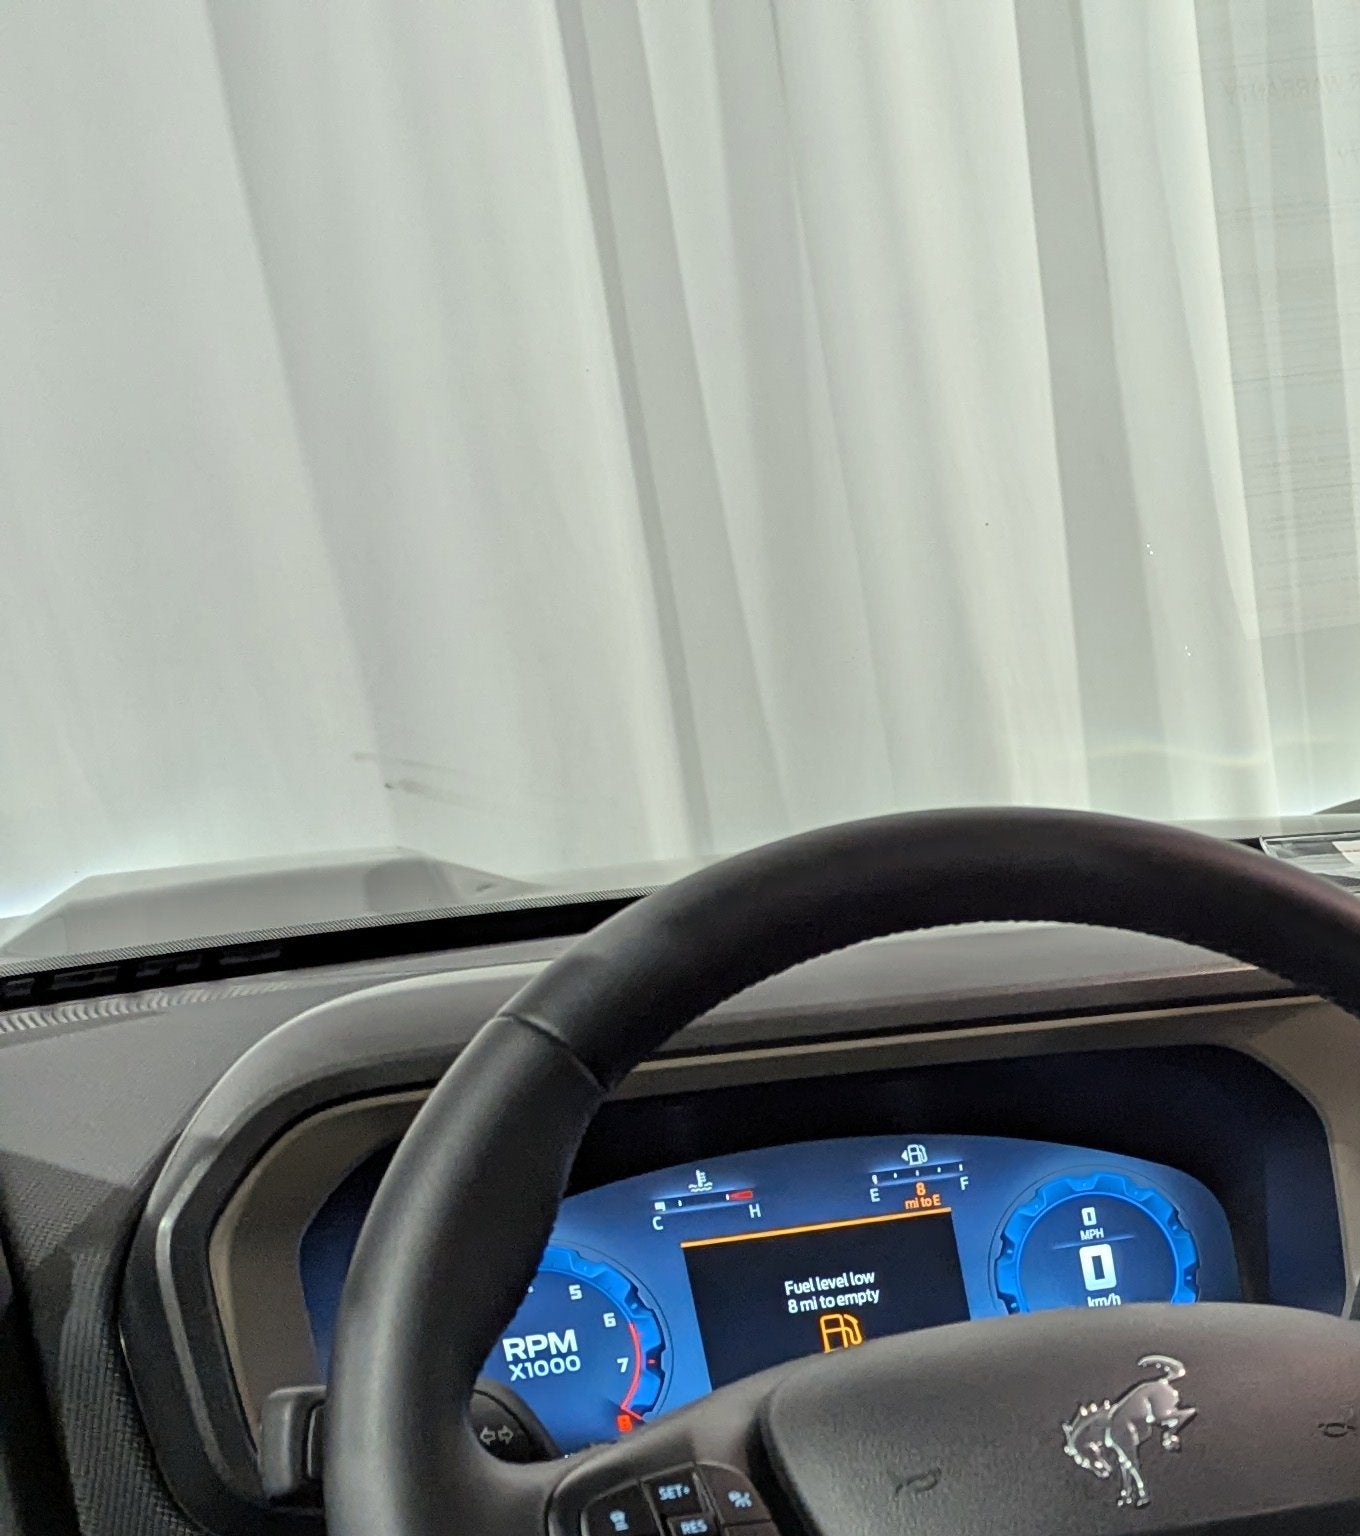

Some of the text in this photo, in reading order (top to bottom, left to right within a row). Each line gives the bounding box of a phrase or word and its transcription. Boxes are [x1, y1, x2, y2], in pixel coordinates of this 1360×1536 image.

[915, 1182, 926, 1196] 8
[960, 1176, 969, 1191] F
[869, 1188, 881, 1203] E
[904, 1193, 941, 1209] mi to E
[749, 1204, 762, 1218] H
[1081, 1207, 1097, 1226] 0
[652, 1216, 664, 1231] C
[1080, 1227, 1104, 1240] MPH
[1079, 1243, 1117, 1291] 0
[784, 1271, 875, 1296] Fuel level low
[568, 1284, 583, 1300] 5
[787, 1288, 880, 1314] 8 mi to empty
[1087, 1293, 1121, 1308] km/h
[603, 1312, 617, 1328] 6
[502, 1328, 578, 1362] RPM
[508, 1355, 581, 1382] X1000
[617, 1357, 629, 1373] 7
[680, 1518, 708, 1535] RES
